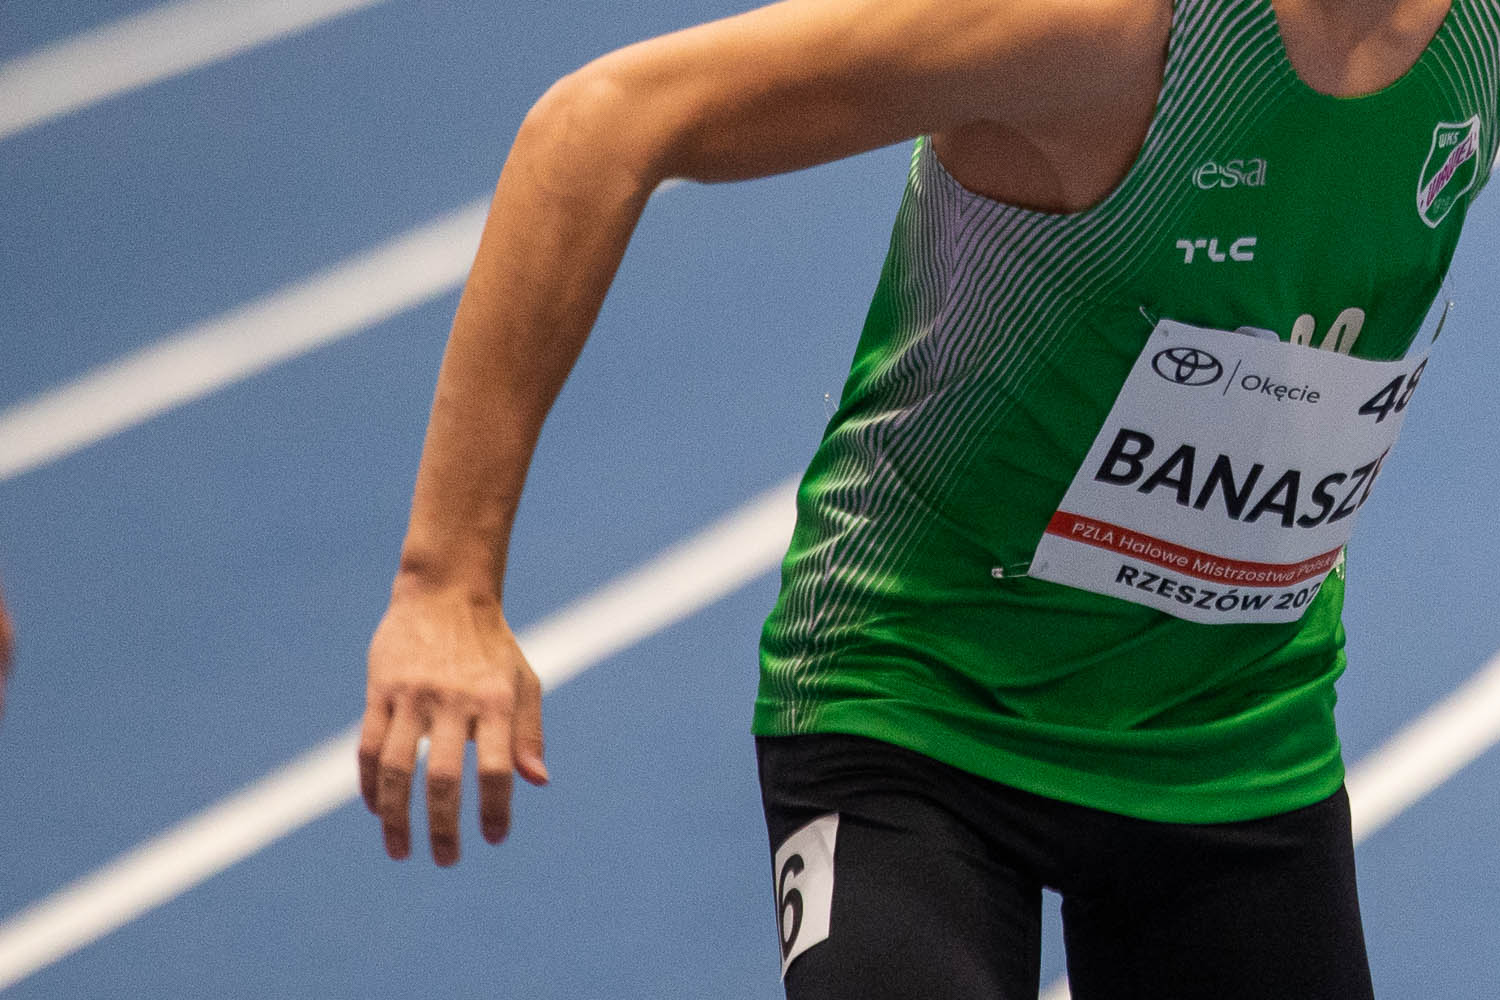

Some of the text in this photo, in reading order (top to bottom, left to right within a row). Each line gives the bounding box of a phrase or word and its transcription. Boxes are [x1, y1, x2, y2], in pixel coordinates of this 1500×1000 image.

[1191, 157, 1268, 190] esa
[1175, 236, 1258, 265] TLC
[1241, 374, 1321, 404] Okęcie
[1071, 522, 1115, 545] PZLA
[1119, 534, 1189, 568] Halowe
[1191, 558, 1296, 583] Mistrzostwa
[1114, 563, 1273, 612] RZESZÓW
[778, 853, 805, 962] 6
